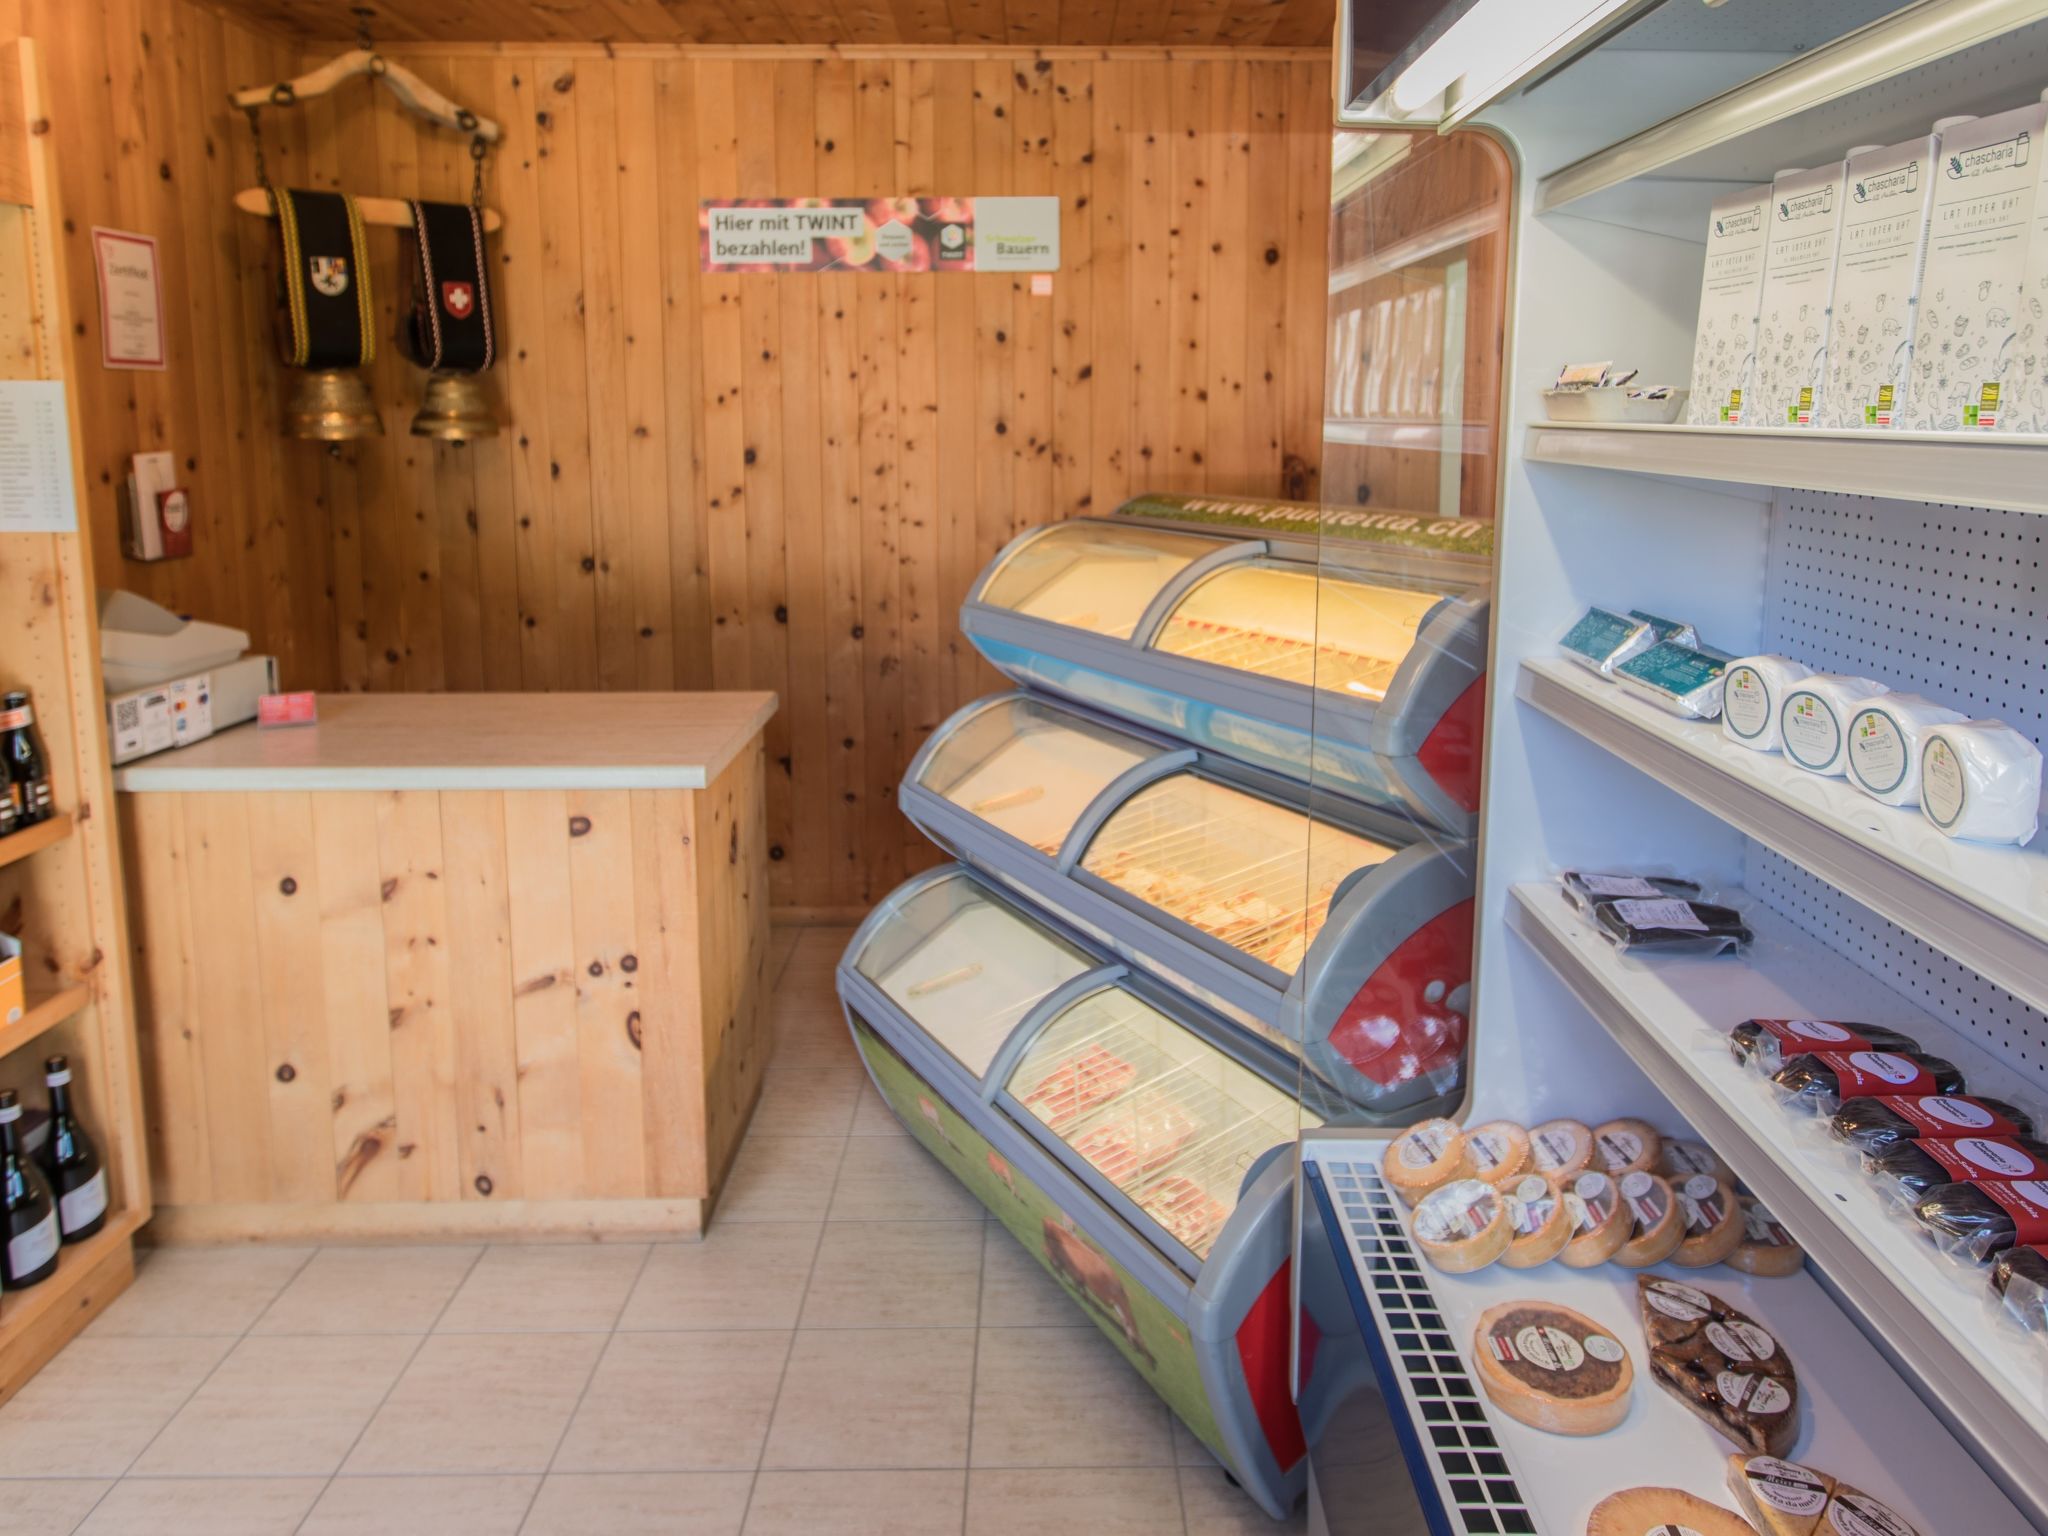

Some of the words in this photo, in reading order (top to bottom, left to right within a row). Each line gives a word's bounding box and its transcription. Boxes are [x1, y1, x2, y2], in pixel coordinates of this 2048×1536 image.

[1964, 146, 2014, 168] chascharia
[1867, 174, 1906, 193] chascharia
[1790, 195, 1823, 213] chascharia
[715, 214, 755, 231] Hier
[759, 214, 790, 231] mit
[794, 213, 859, 231] TWINT
[716, 238, 806, 258] bezahlen!
[996, 242, 1050, 255] Bauern
